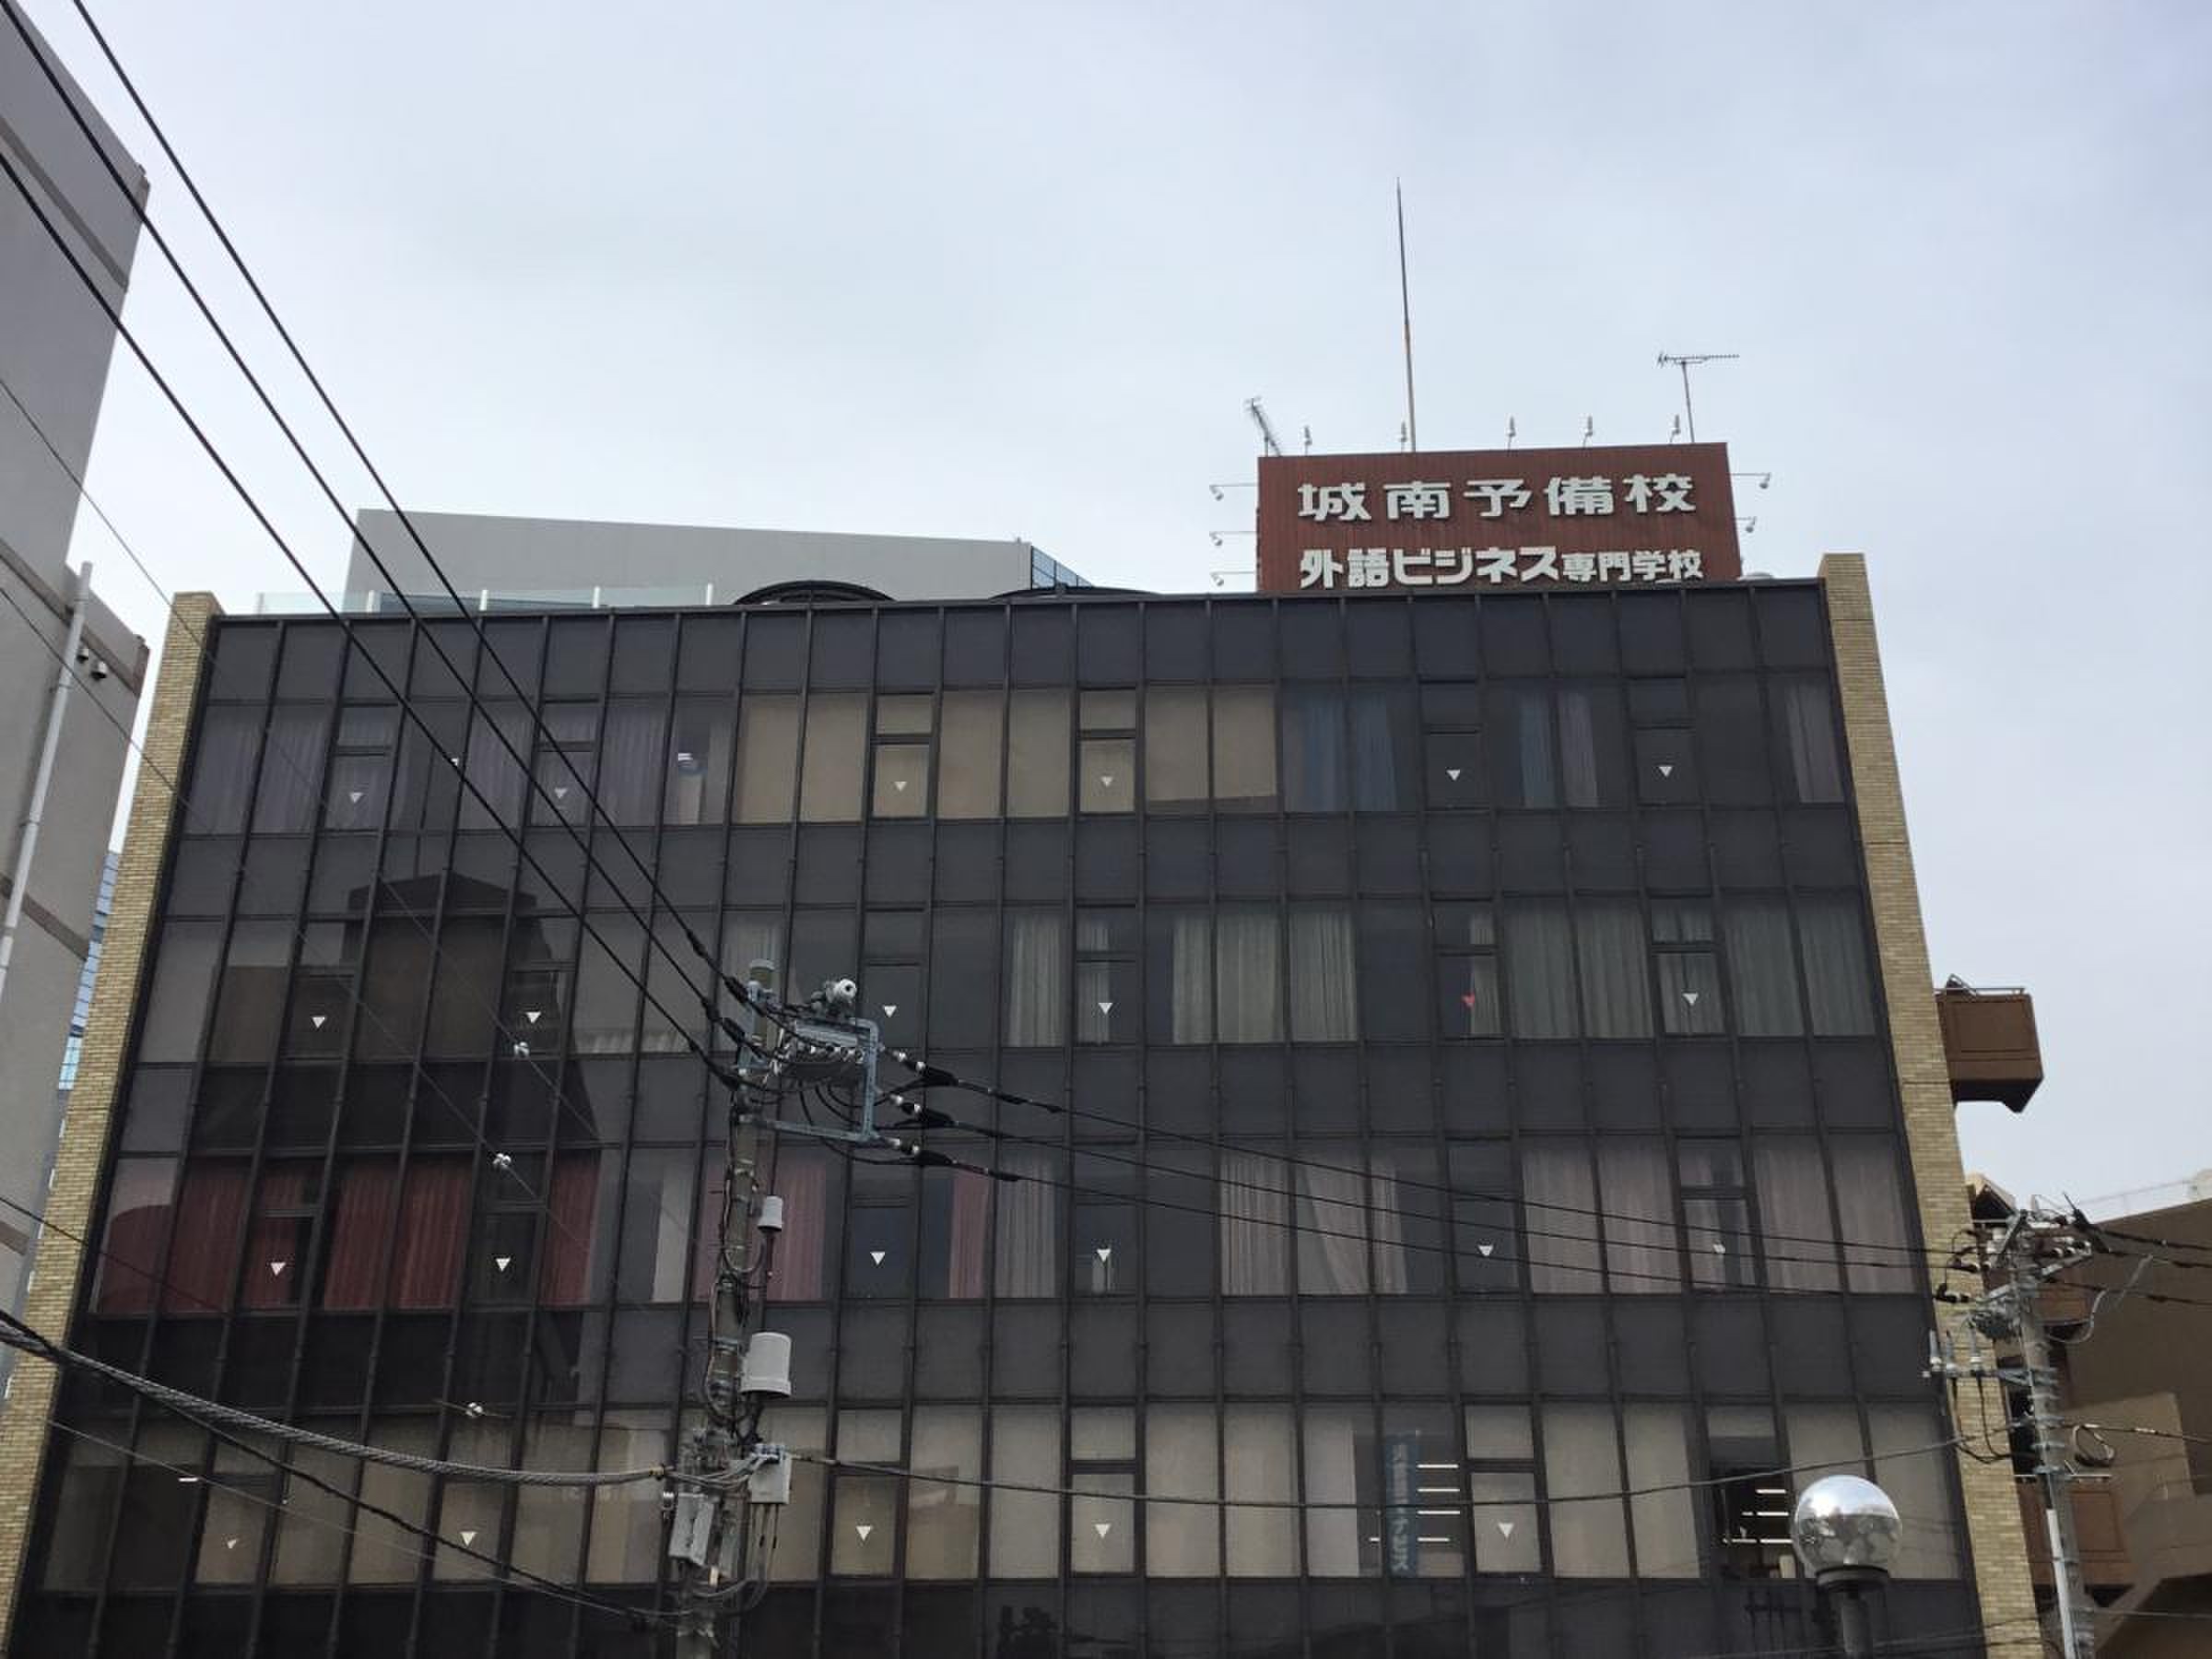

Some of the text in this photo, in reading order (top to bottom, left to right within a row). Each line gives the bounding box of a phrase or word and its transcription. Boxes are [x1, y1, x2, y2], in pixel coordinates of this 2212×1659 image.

[1298, 474, 1697, 522] 城南予備校
[1300, 546, 1703, 589] 外語ビジネス専門学校
